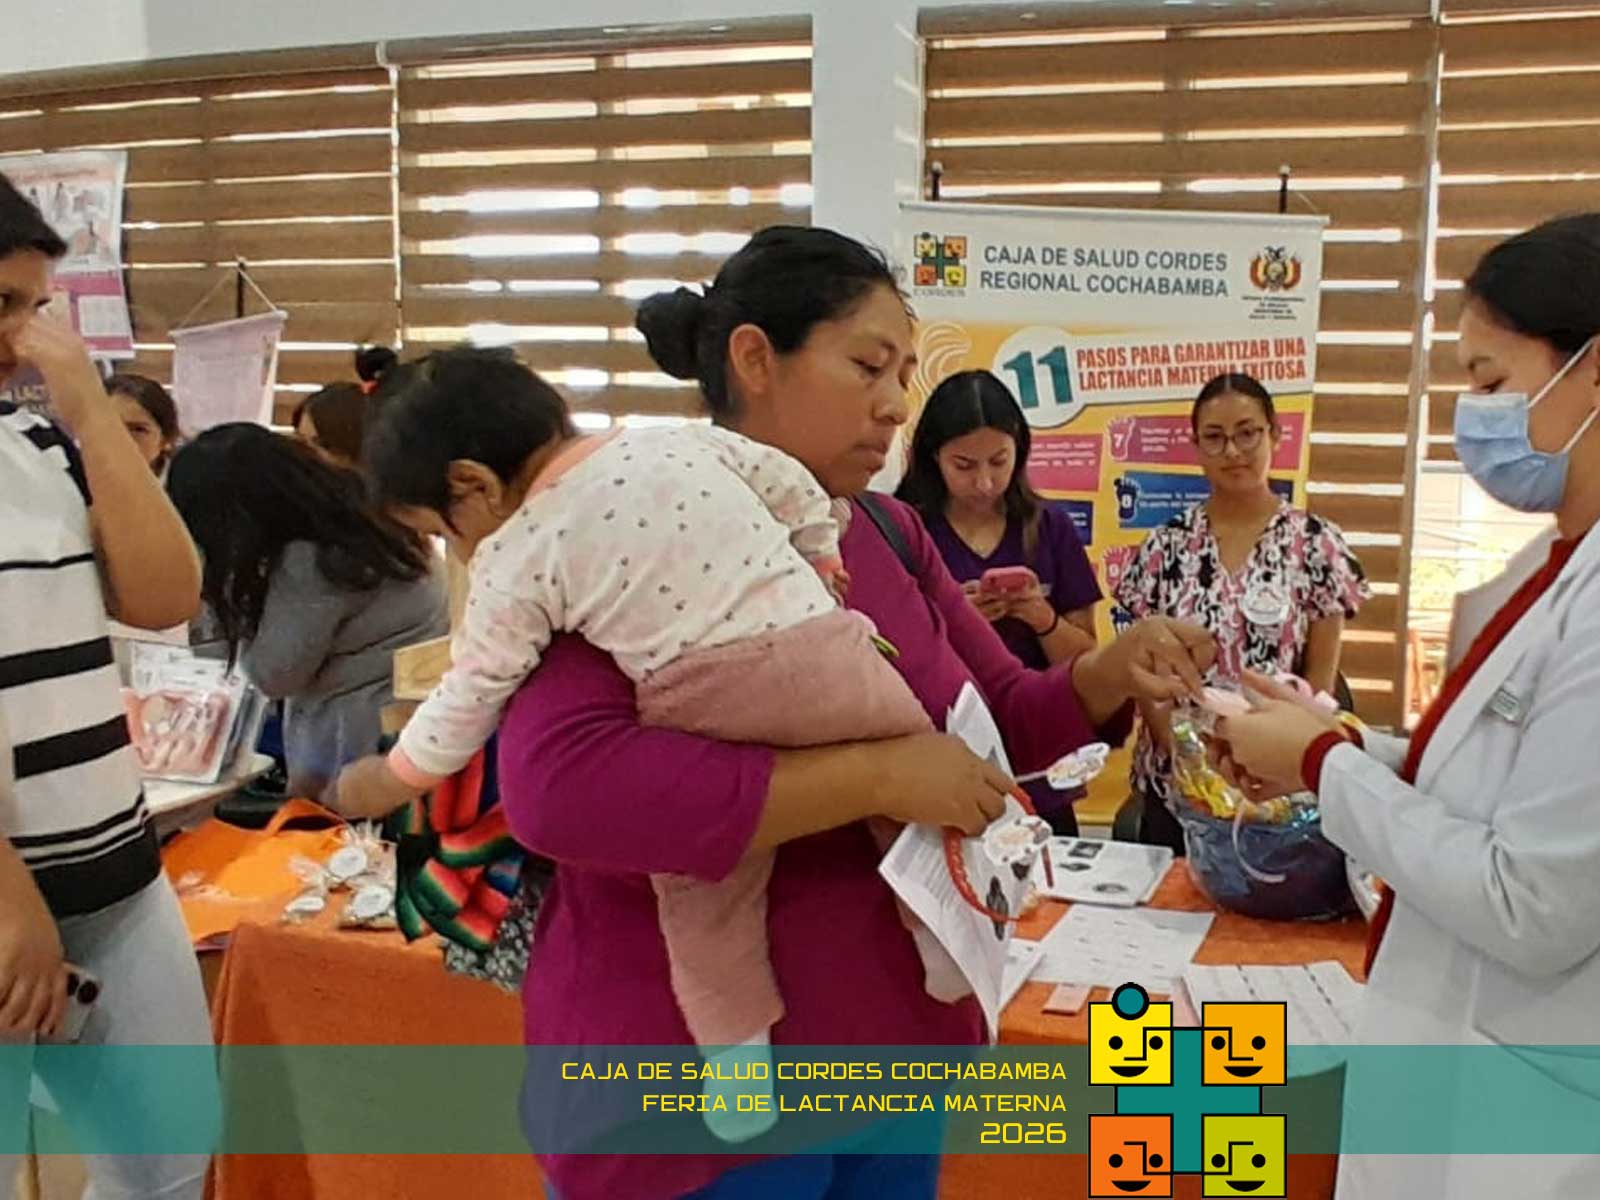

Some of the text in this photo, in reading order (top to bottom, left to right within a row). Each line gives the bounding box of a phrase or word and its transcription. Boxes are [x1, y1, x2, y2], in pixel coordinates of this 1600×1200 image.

[984, 246, 1228, 271] CAJA DE SALUD CORDES
[980, 271, 1229, 297] REGIONAL COCHABAMBA
[1076, 337, 1306, 369] PASOS PARA GARANTIZAR UNA
[1002, 345, 1074, 409] 11
[1079, 367, 1163, 390] LACTANCIA
[1113, 433, 1125, 448] 7
